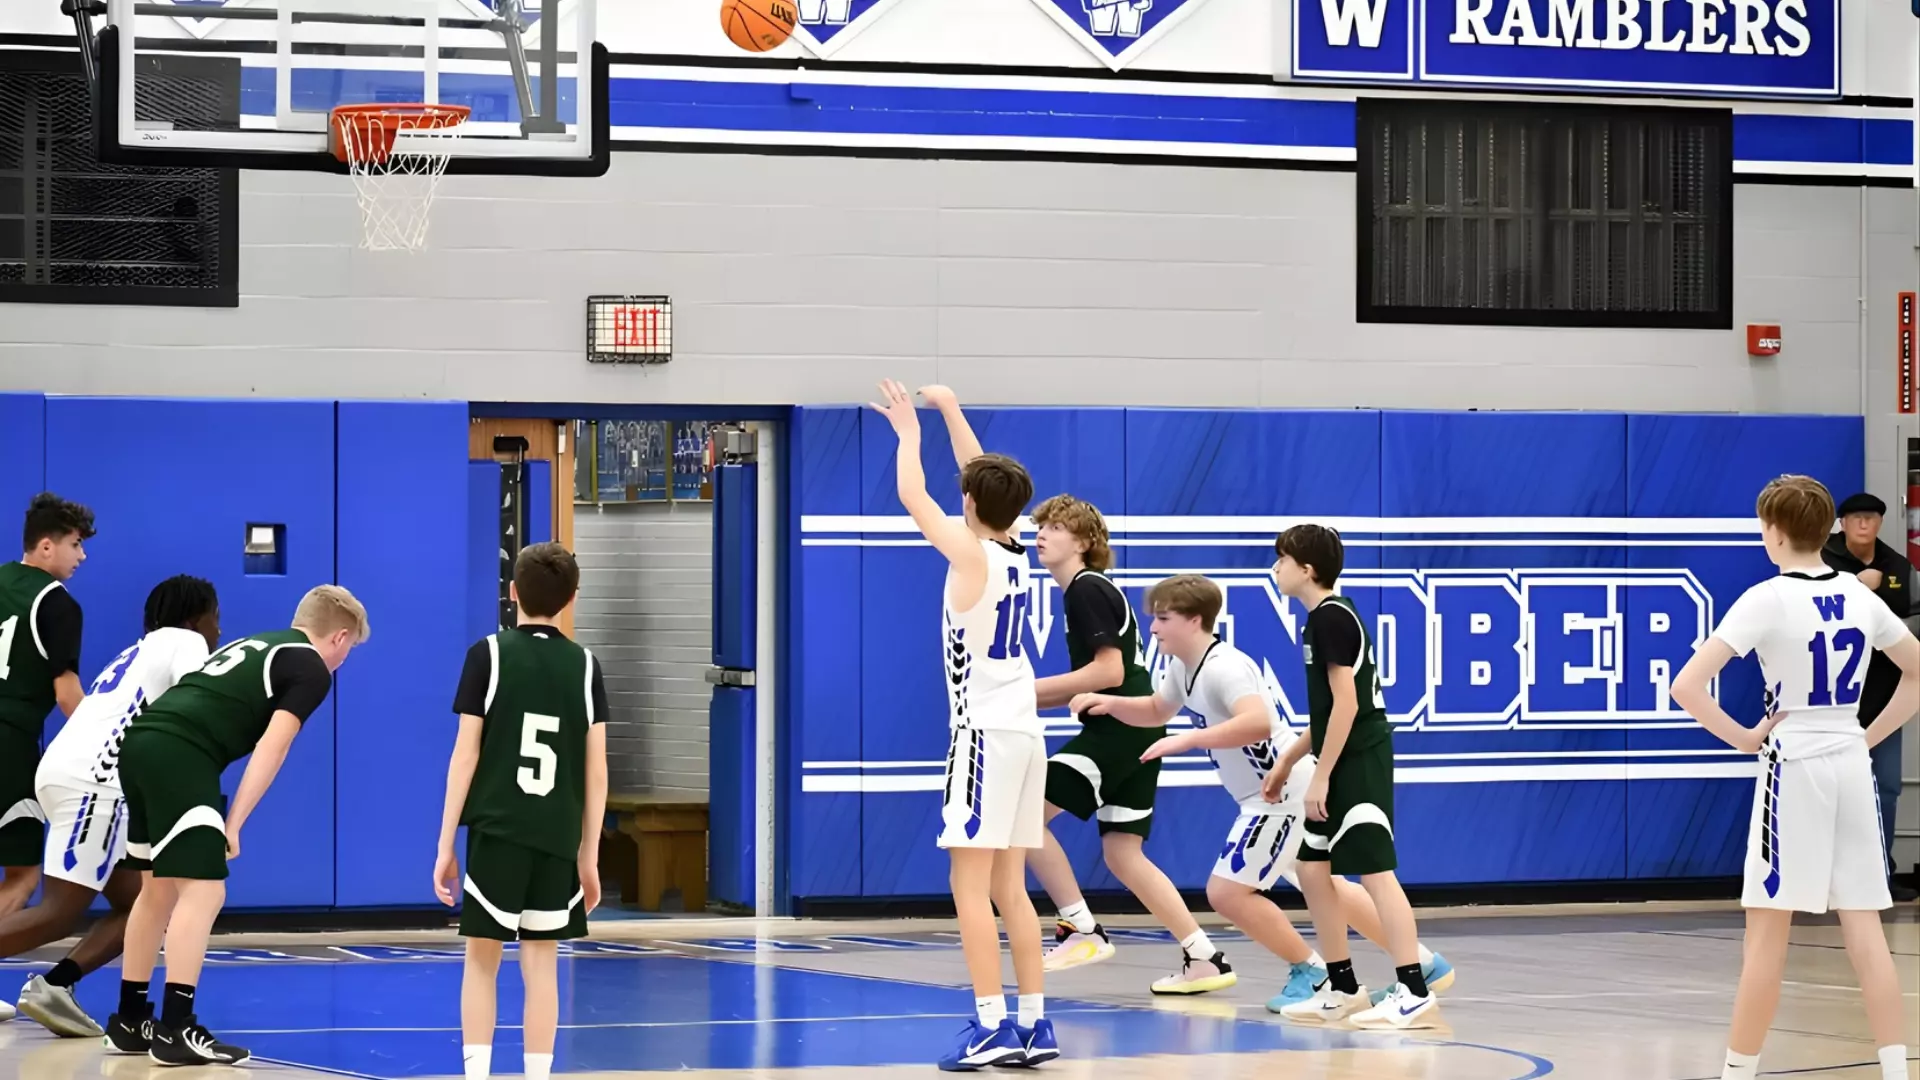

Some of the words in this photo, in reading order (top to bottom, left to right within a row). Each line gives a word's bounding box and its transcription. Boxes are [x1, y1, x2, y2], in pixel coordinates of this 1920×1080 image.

[1320, 0, 1389, 48] W
[1449, 0, 1811, 57] RAMBLERS
[614, 306, 660, 346] EXIT
[1812, 594, 1846, 622] W
[1808, 627, 1866, 706] 12
[516, 712, 561, 797] 5
